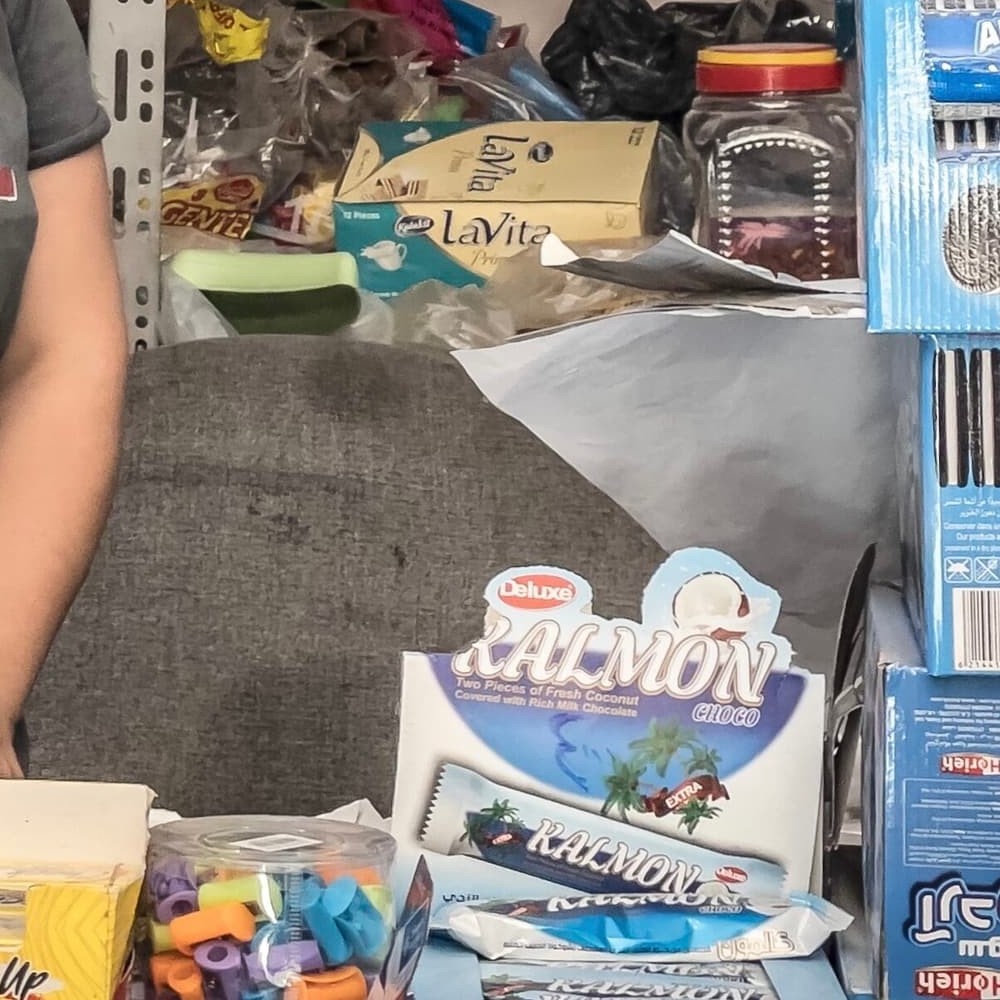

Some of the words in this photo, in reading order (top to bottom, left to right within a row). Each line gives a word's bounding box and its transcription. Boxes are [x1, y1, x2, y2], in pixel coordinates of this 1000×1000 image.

[468, 135, 529, 192] LaVita
[443, 209, 551, 246] LaVita
[500, 578, 574, 602] Deluxe
[451, 618, 780, 706] KALMON
[455, 690, 501, 703] Covered
[503, 693, 526, 707] with
[528, 696, 554, 709] Rich
[557, 698, 579, 712] Milk
[582, 702, 638, 718] Chocolate
[456, 677, 481, 690] Two
[484, 680, 526, 695] Pieces
[530, 684, 544, 696] of
[546, 686, 581, 700] Fresh
[585, 690, 640, 706] Coconut
[692, 702, 761, 728] CHOCO
[665, 780, 703, 809] EXTRA
[527, 818, 705, 894] KALMON
[915, 884, 995, 942] آرد
[0, 956, 51, 1000] Up
